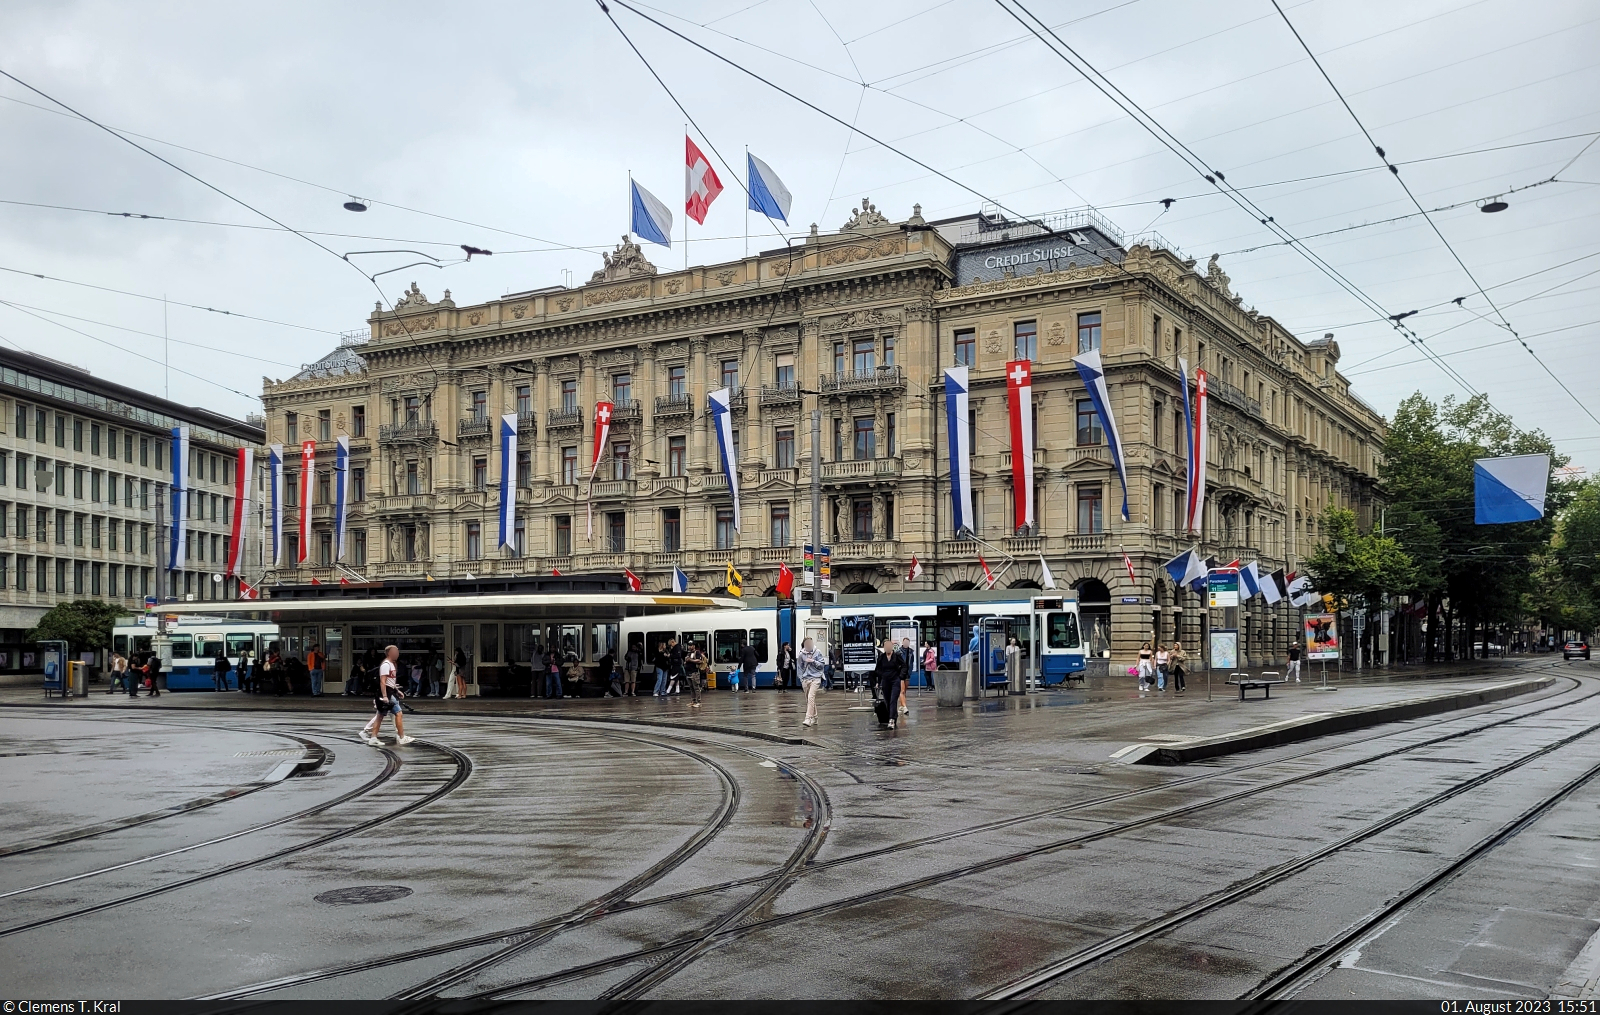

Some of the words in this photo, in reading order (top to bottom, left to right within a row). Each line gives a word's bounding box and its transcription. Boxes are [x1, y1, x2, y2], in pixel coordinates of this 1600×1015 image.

[984, 252, 1033, 269] CREDIT
[1033, 245, 1075, 262] SUISSE
[390, 626, 410, 635] kiosk
